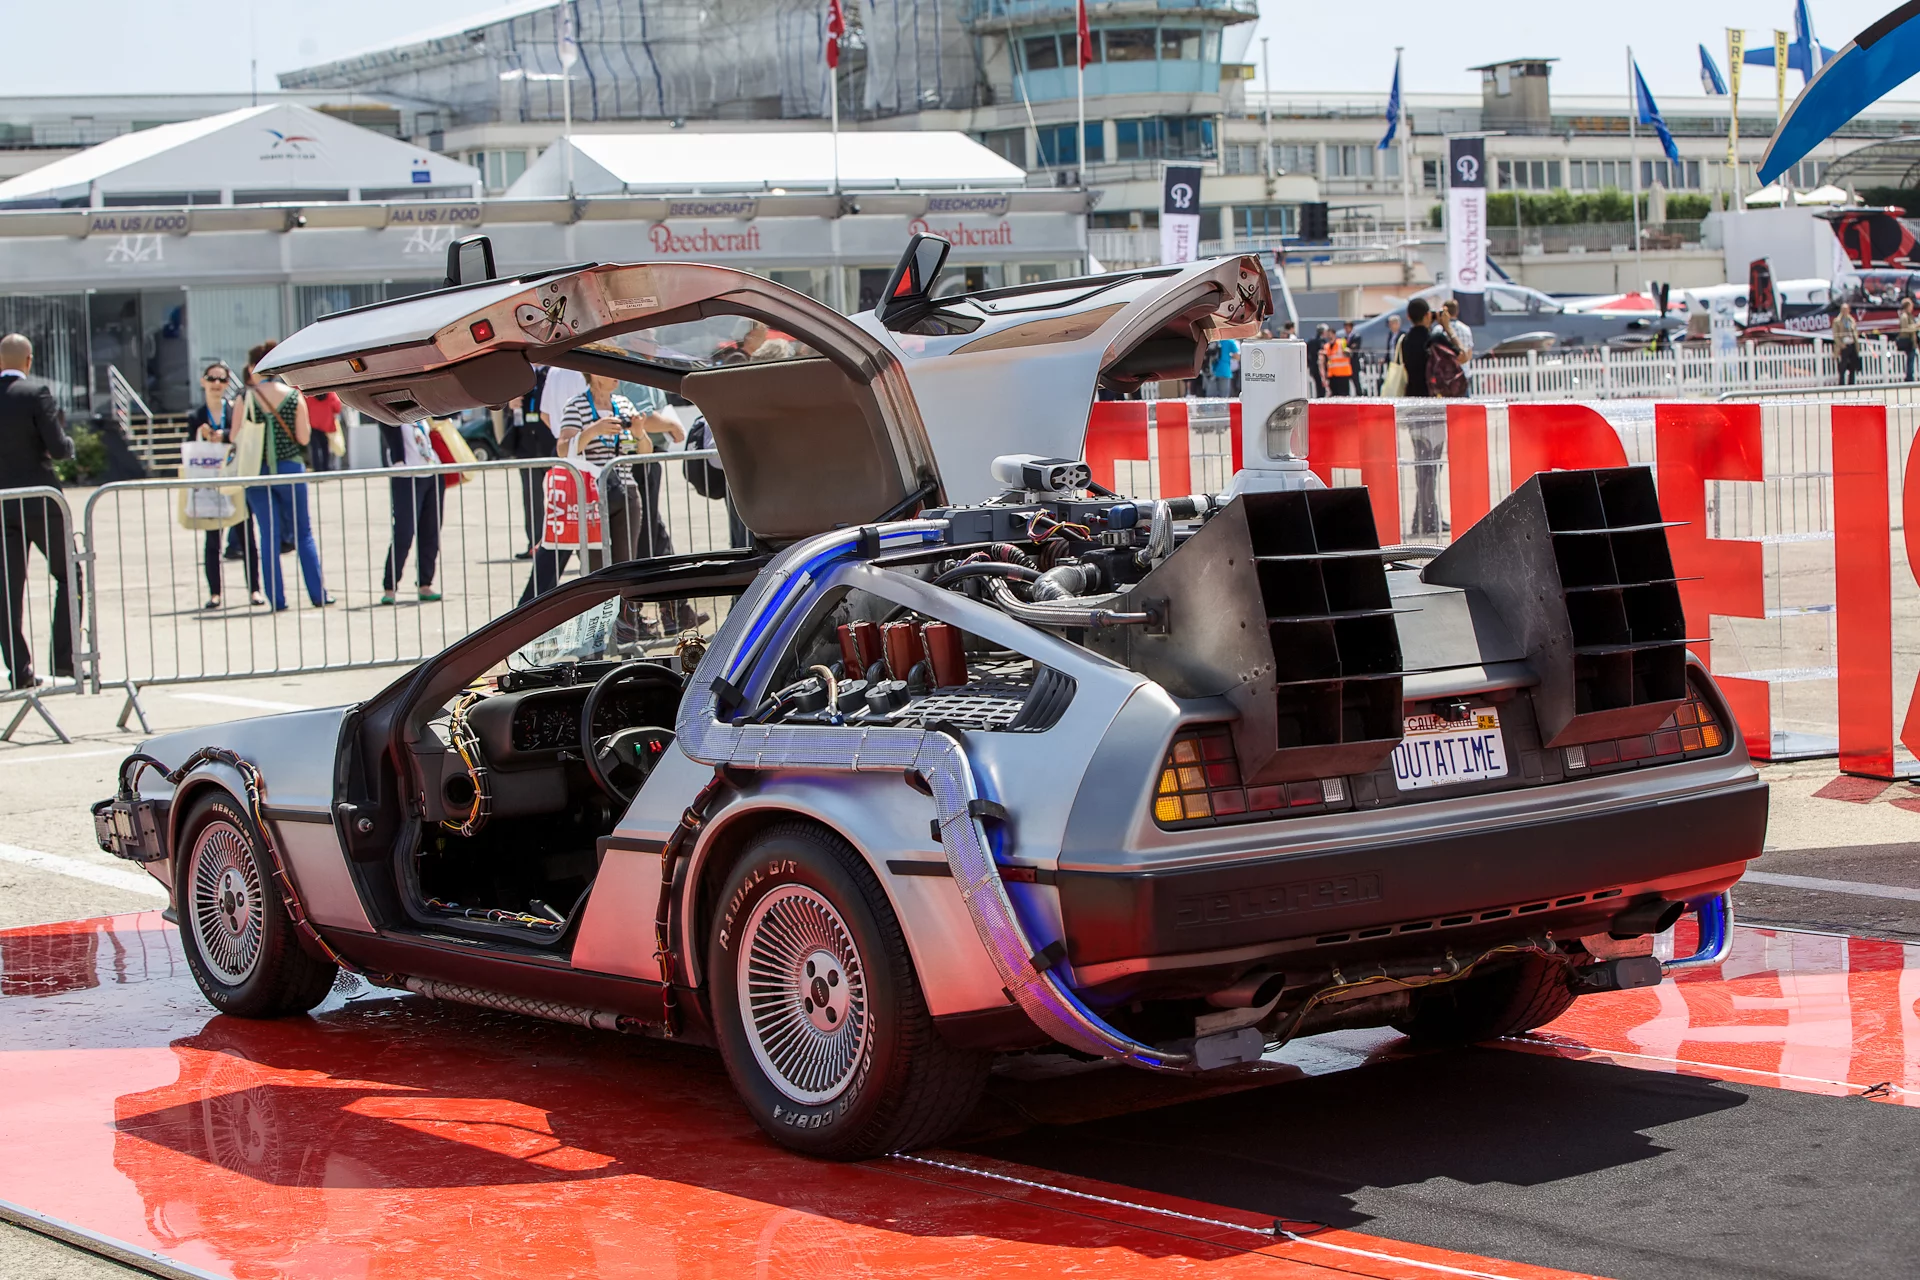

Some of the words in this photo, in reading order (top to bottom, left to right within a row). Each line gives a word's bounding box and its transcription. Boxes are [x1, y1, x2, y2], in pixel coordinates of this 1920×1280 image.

[392, 209, 414, 222] AIA
[418, 208, 437, 221] US
[669, 202, 755, 216] BEECHCRAFT
[928, 198, 1007, 211] BEECHCRAFT
[92, 218, 117, 231] AIA
[121, 217, 141, 231] US
[648, 223, 762, 253] Beechcraft
[1172, 224, 1189, 263] craft
[1458, 197, 1478, 286] Beechcraft
[547, 475, 567, 530] LEAP
[1394, 734, 1501, 780] OUTATIME
[212, 803, 254, 848] HERCULES
[719, 869, 765, 951] RADIAL
[769, 859, 798, 875] G/T
[773, 1104, 834, 1129] COBRA
